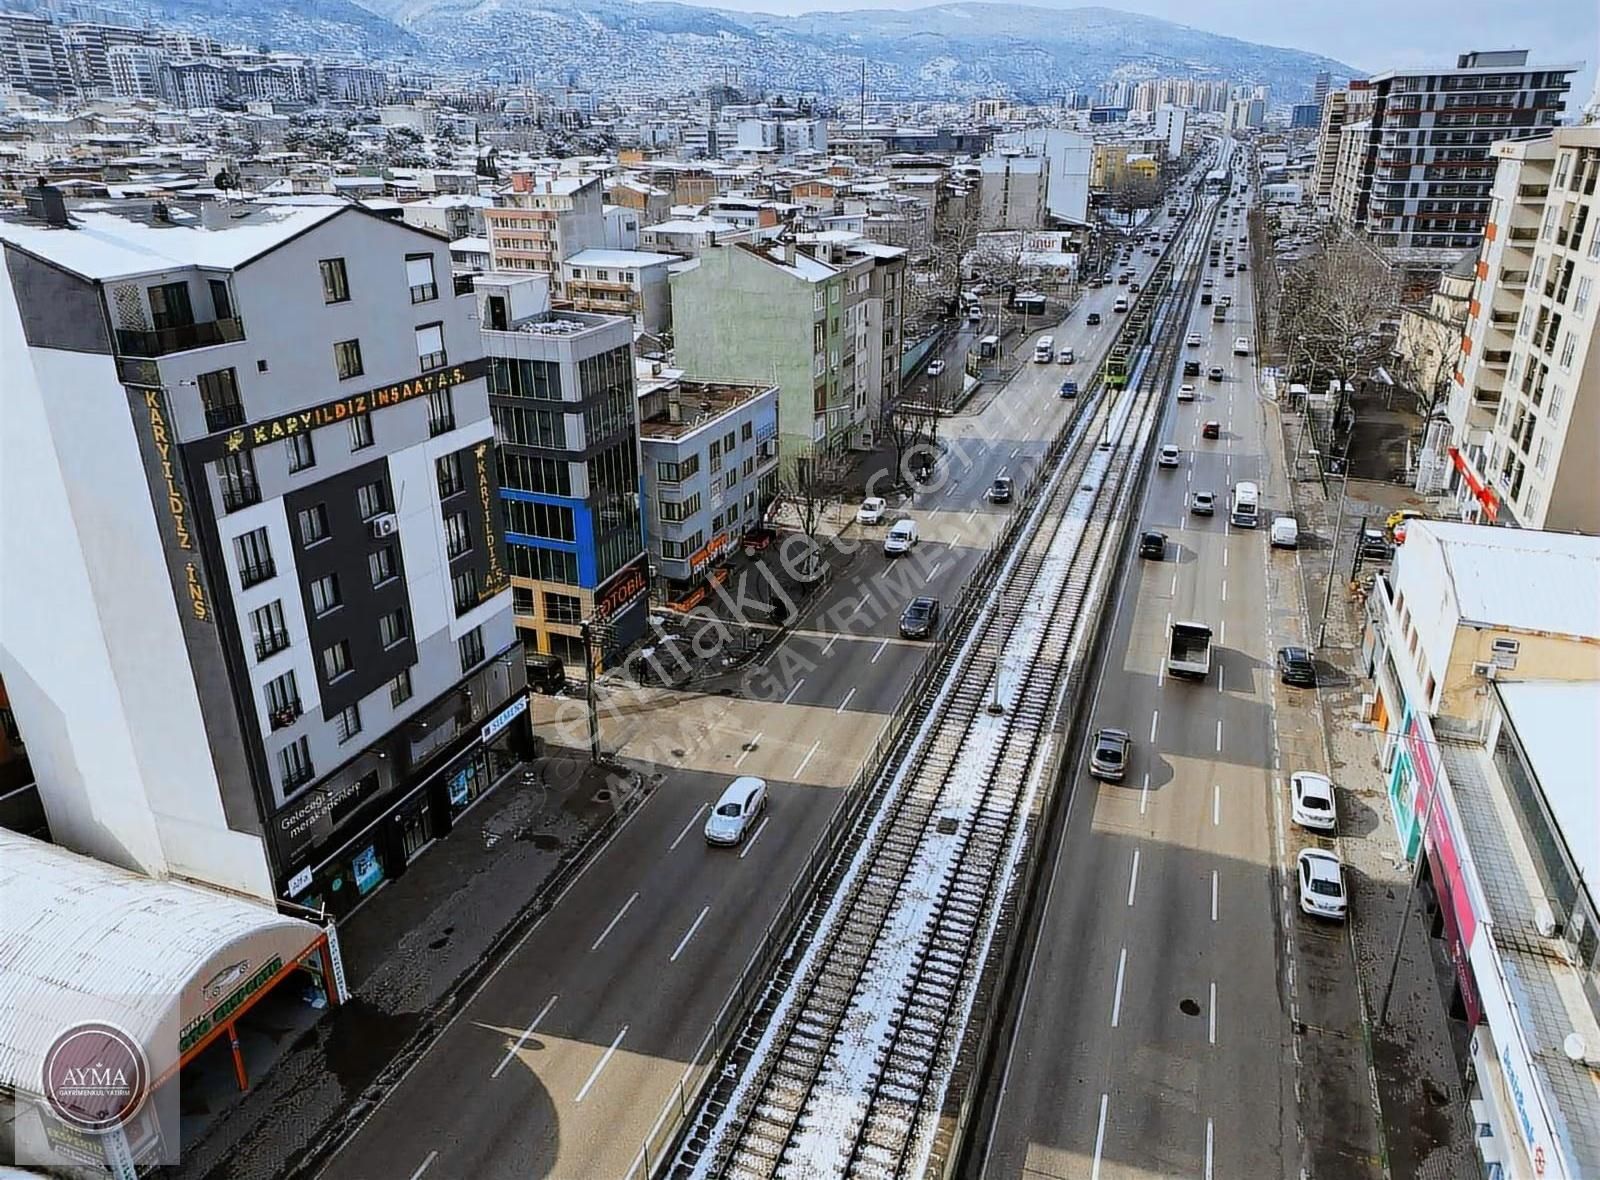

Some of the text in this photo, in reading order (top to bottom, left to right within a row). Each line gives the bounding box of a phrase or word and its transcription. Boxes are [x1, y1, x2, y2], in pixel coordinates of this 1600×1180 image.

[252, 395, 368, 445] KARYILDIZ
[370, 376, 433, 408] İNŞAAT
[144, 390, 191, 550] KARYILDIZ
[477, 462, 497, 570] KARYILDIZ
[492, 702, 524, 730] SIEMENS
